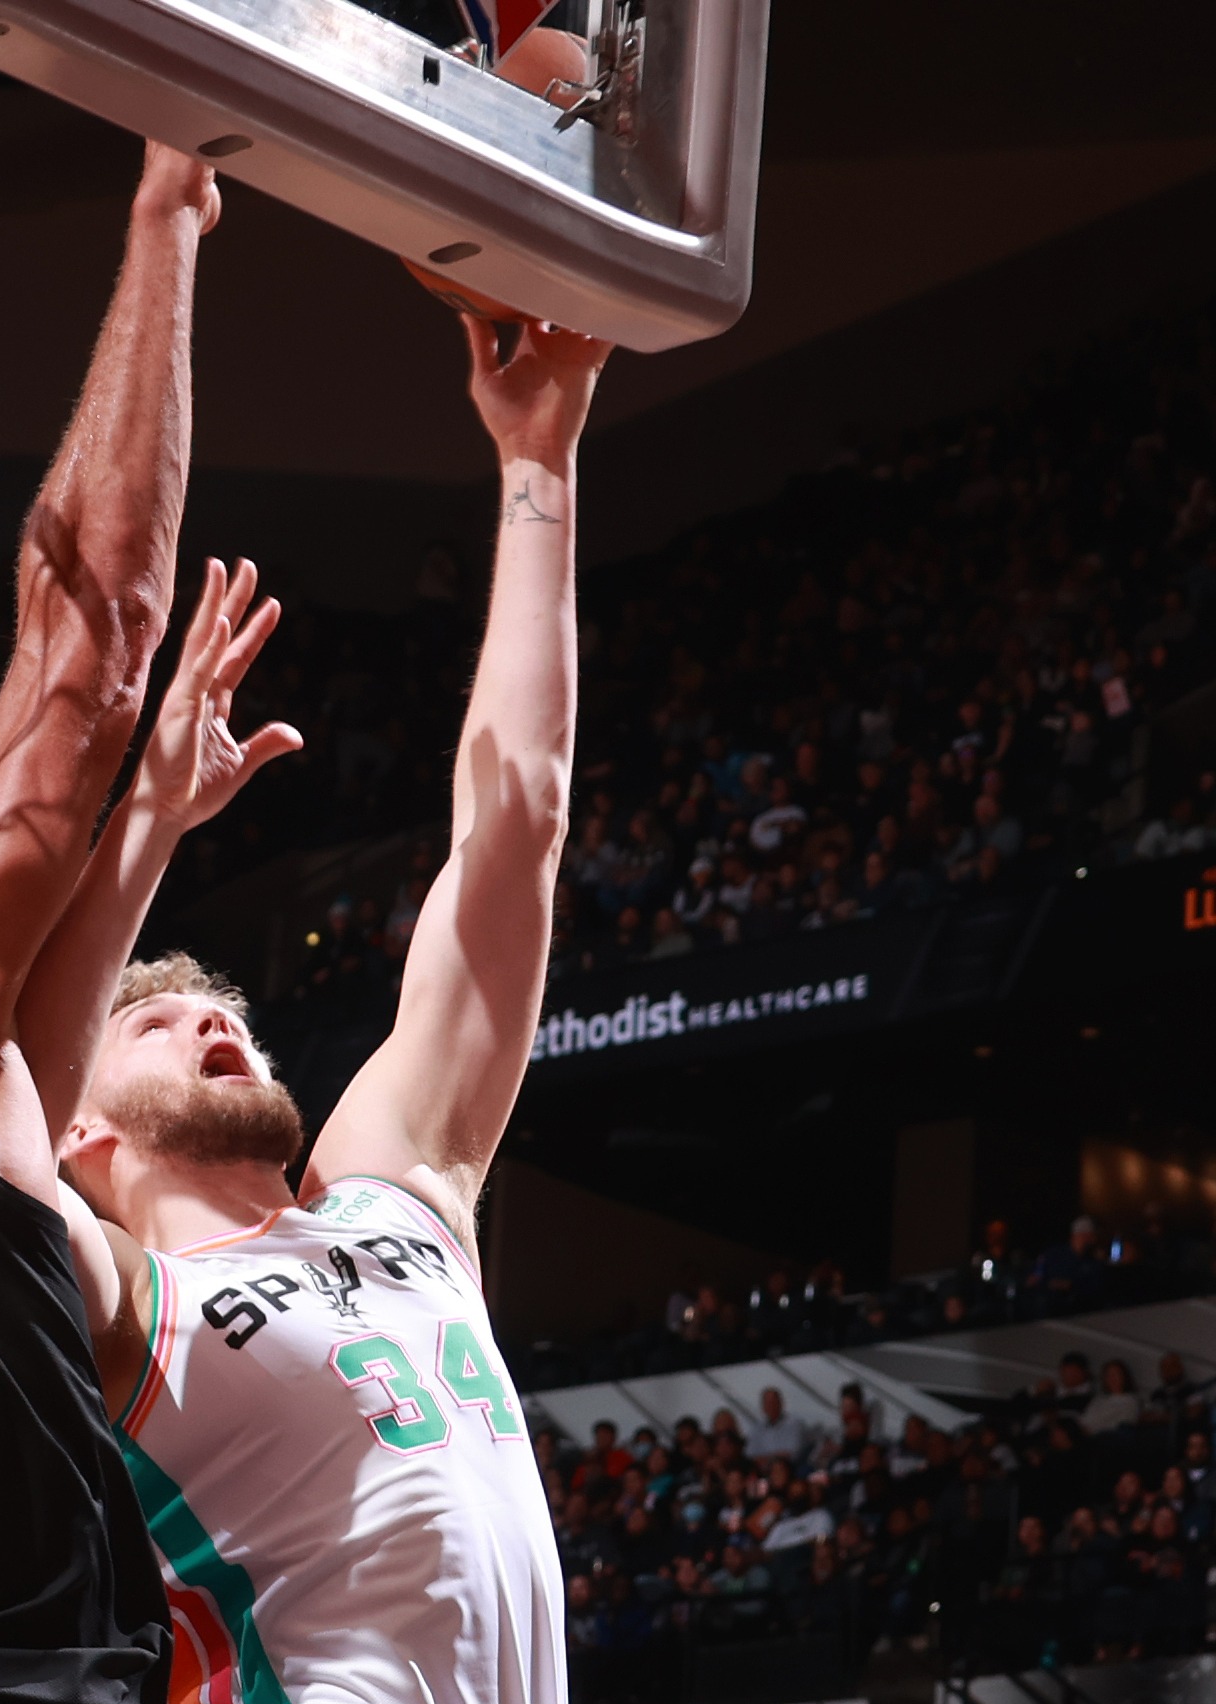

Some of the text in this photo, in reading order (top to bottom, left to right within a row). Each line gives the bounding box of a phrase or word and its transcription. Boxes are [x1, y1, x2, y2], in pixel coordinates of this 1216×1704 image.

[688, 975, 868, 1030] HEALTHCARE
[328, 1190, 380, 1225] rost
[329, 1317, 523, 1457] 34
